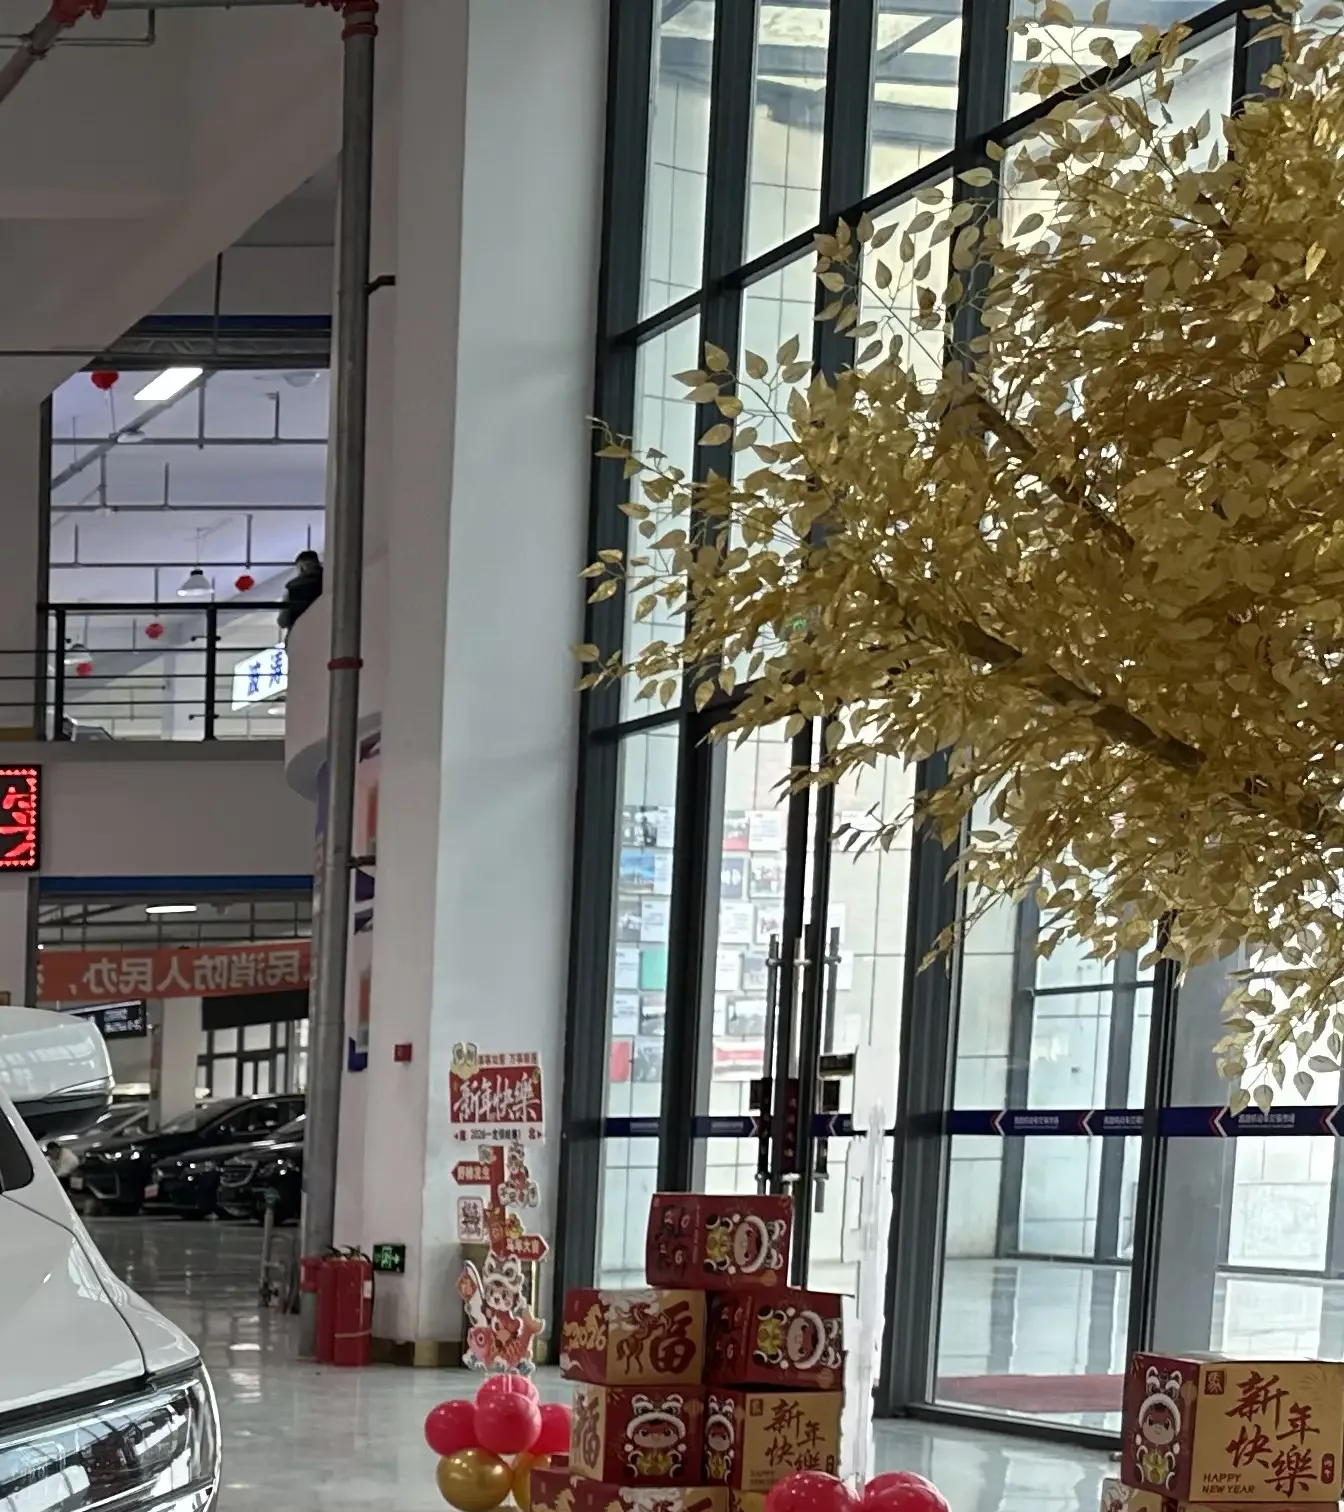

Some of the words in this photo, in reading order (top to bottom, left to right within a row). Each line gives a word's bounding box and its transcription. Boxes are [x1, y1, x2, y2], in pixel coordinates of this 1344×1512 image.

[1203, 1472, 1242, 1483] HAPPY
[1201, 1484, 1226, 1494] NEW
[1227, 1484, 1256, 1494] YEAR
